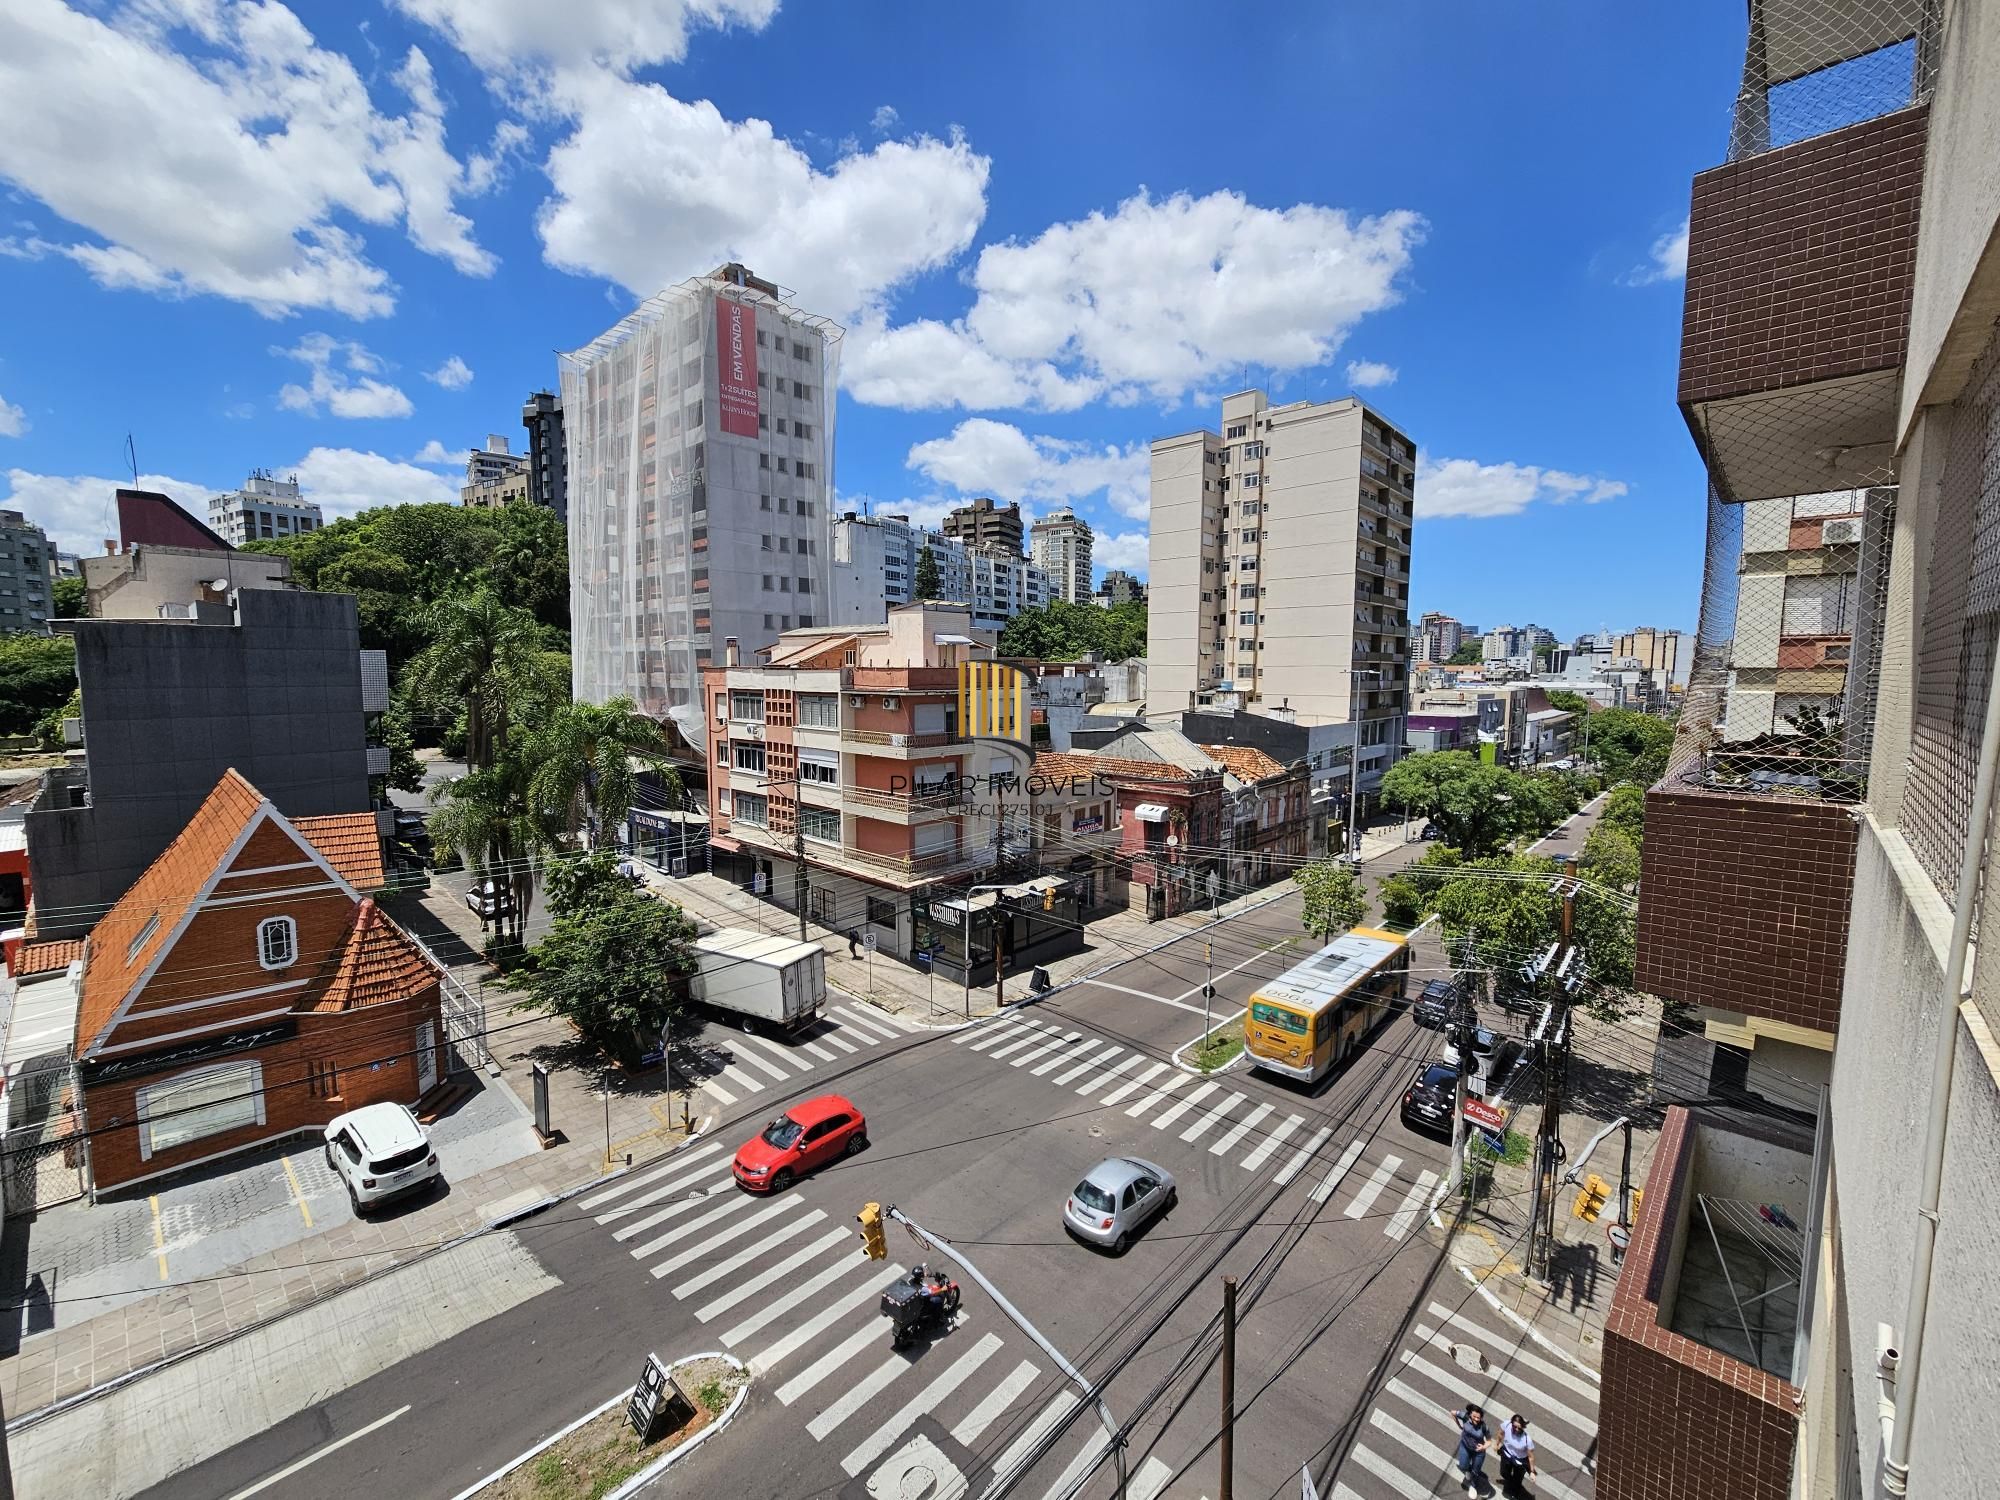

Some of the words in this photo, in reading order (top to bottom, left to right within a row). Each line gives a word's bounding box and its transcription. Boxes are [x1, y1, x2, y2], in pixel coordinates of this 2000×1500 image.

[732, 306, 742, 359] VENDAS
[733, 361, 743, 381] EM
[1475, 1107, 1501, 1122] Desco
